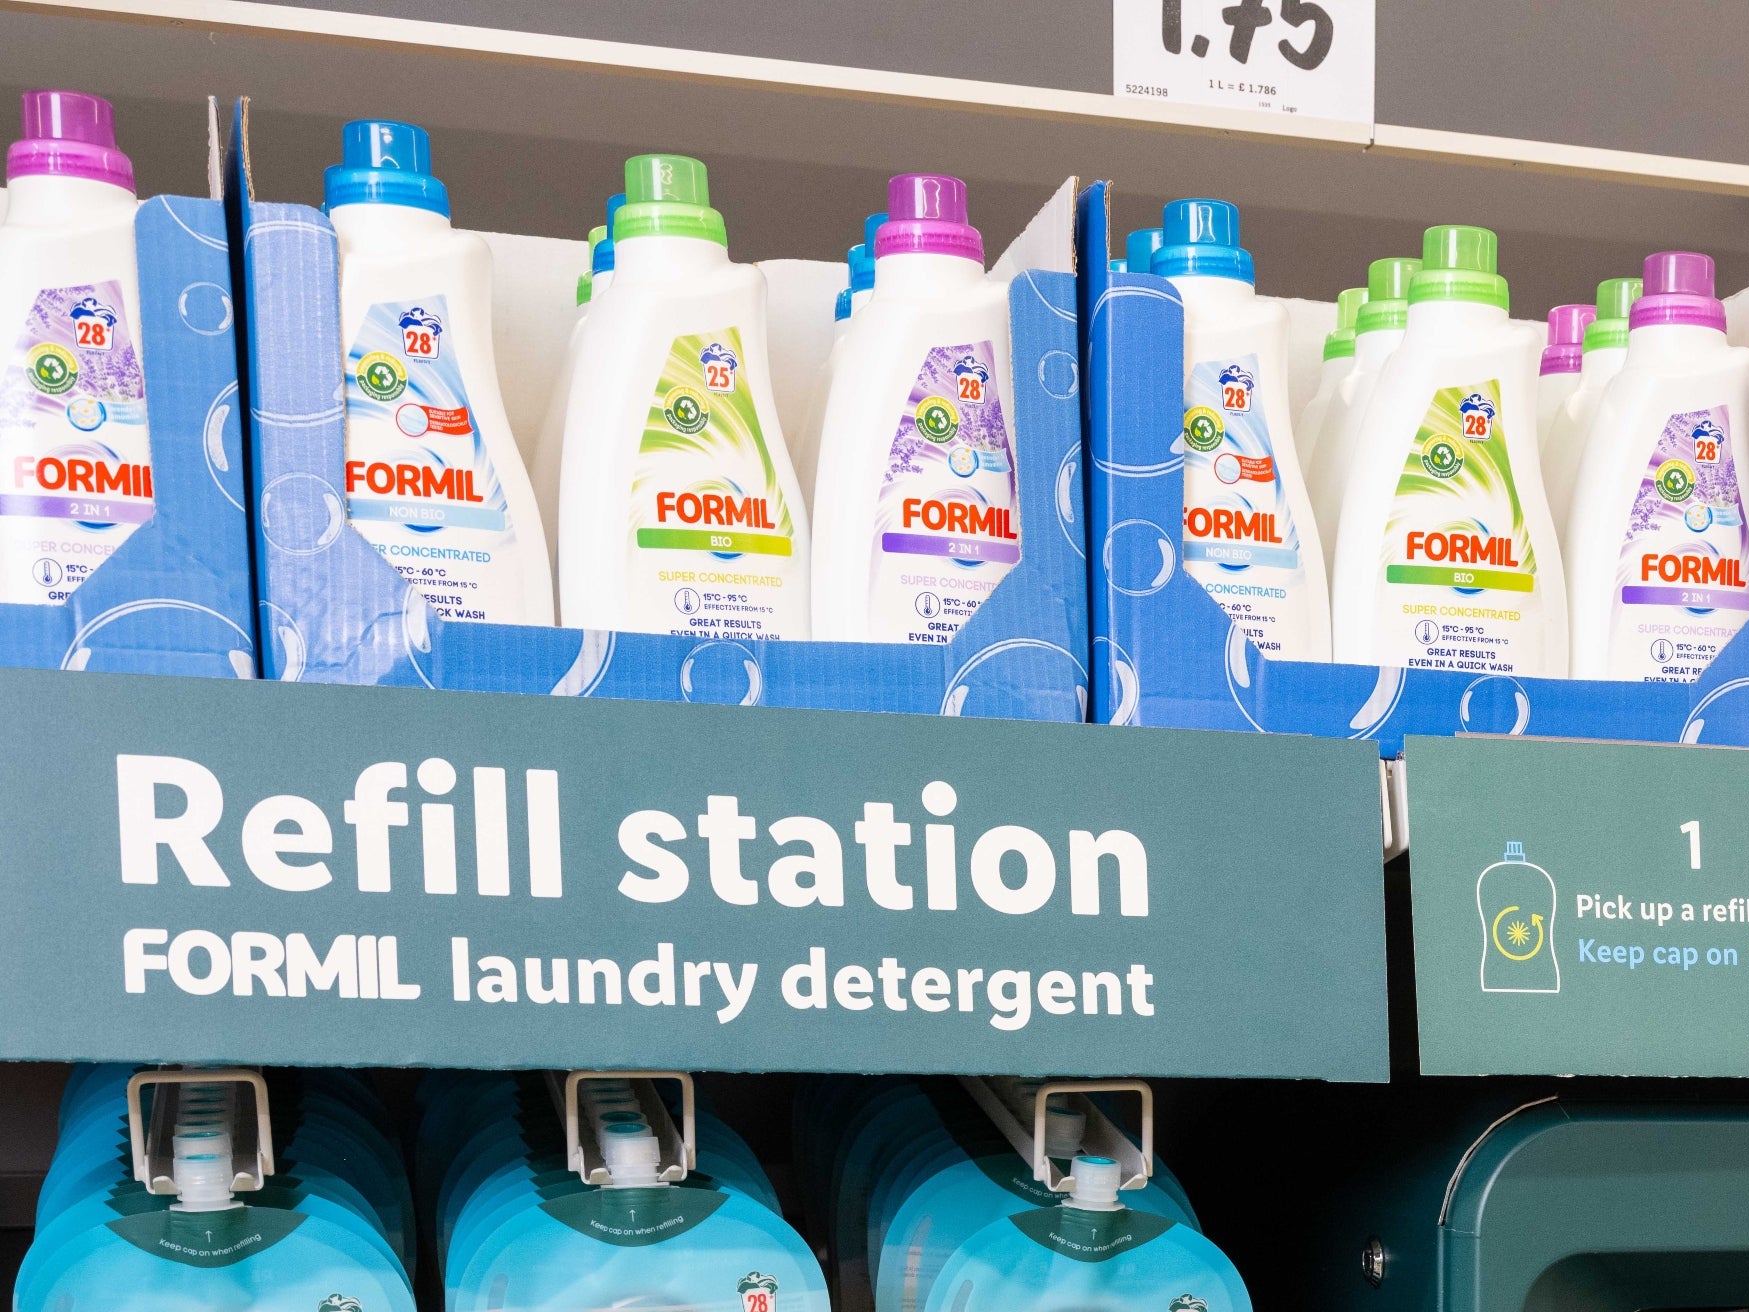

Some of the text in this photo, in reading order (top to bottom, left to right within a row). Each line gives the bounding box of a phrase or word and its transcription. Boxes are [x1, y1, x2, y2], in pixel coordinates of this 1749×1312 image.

[1126, 84, 1168, 97] 5224198
[1218, 81, 1224, 90] L
[1239, 82, 1245, 92] £
[1249, 84, 1277, 95] 1.786
[657, 490, 775, 529] FORMIL
[710, 536, 732, 547] BIO
[117, 754, 1148, 916] Refill station
[1680, 821, 1700, 869] 1
[1577, 894, 1632, 919] Pick
[1641, 903, 1673, 926] up
[1682, 904, 1694, 921] a
[1579, 939, 1737, 970] Keep cap on
[124, 929, 1154, 1030] FORMIL laundry detergent
